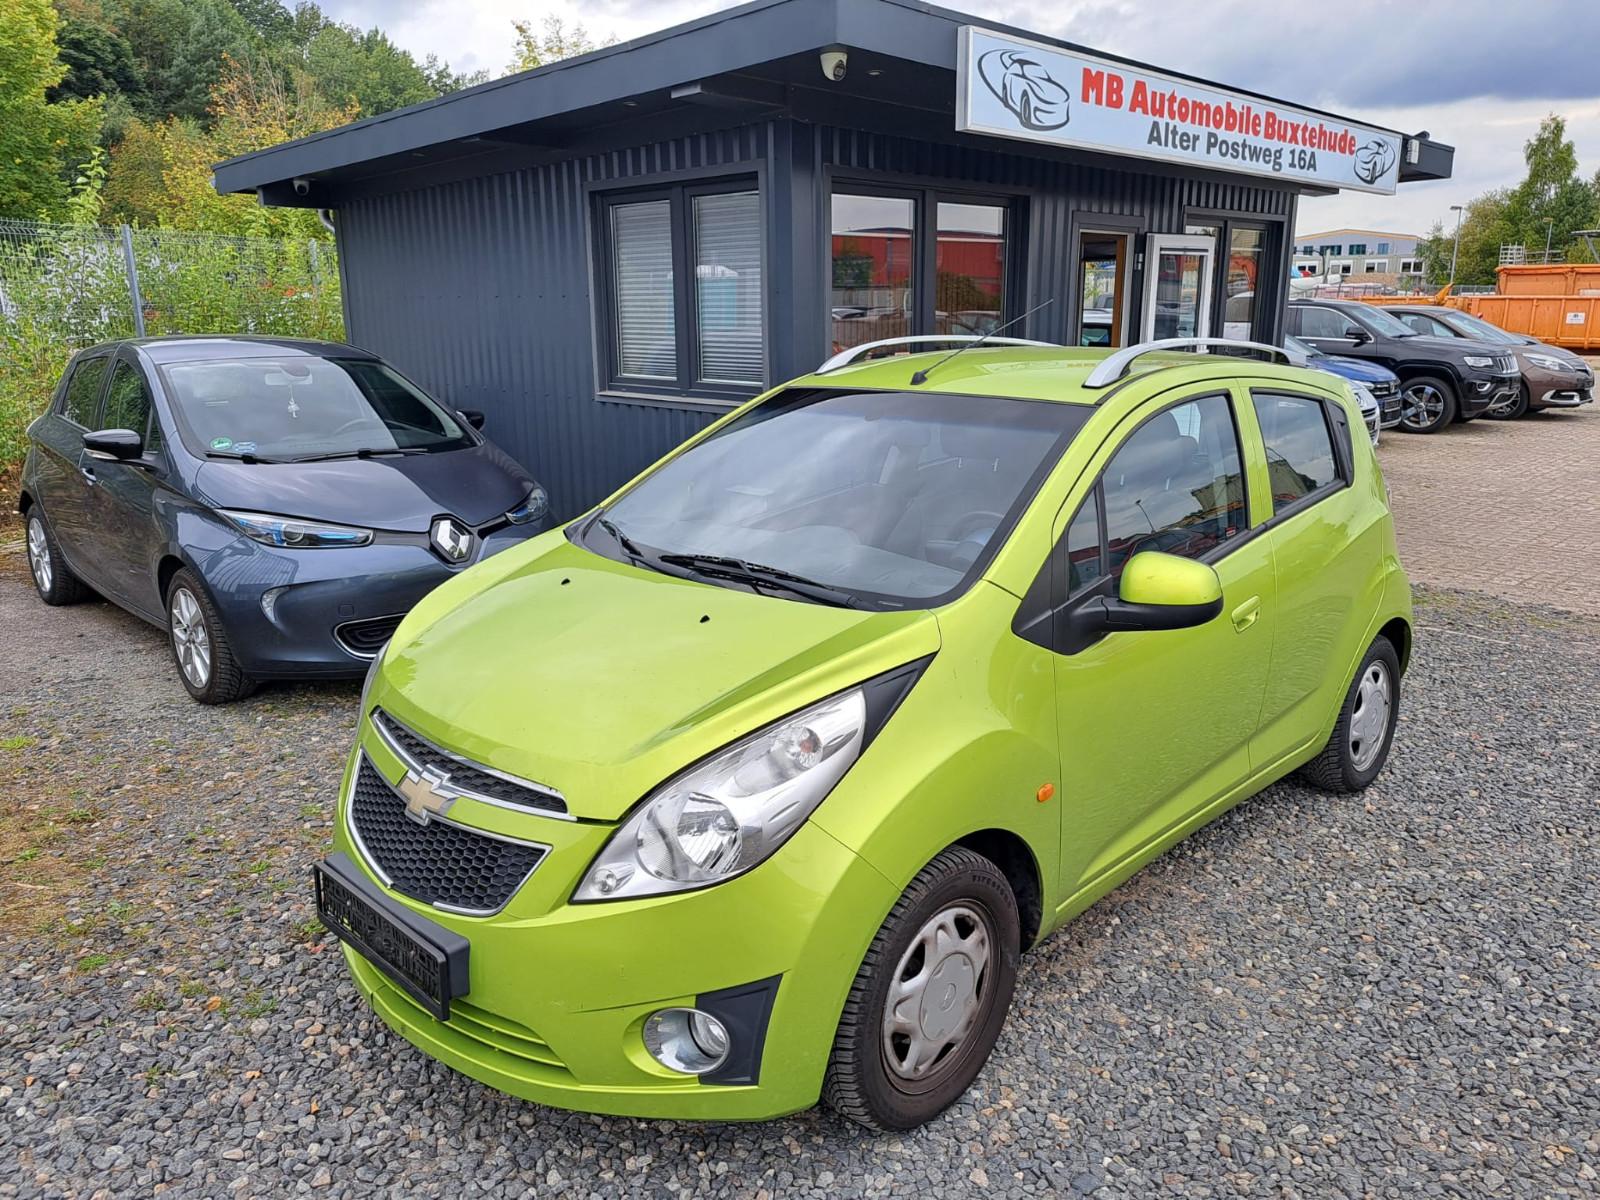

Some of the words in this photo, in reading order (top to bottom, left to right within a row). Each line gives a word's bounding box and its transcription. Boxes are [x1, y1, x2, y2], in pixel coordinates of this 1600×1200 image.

[1081, 67, 1124, 109] MB
[1128, 80, 1262, 137] Automobile
[1263, 111, 1356, 156] Buxtehude
[1147, 120, 1200, 153] Alter
[1206, 131, 1284, 172] Postweg
[1288, 149, 1317, 172] 16A
